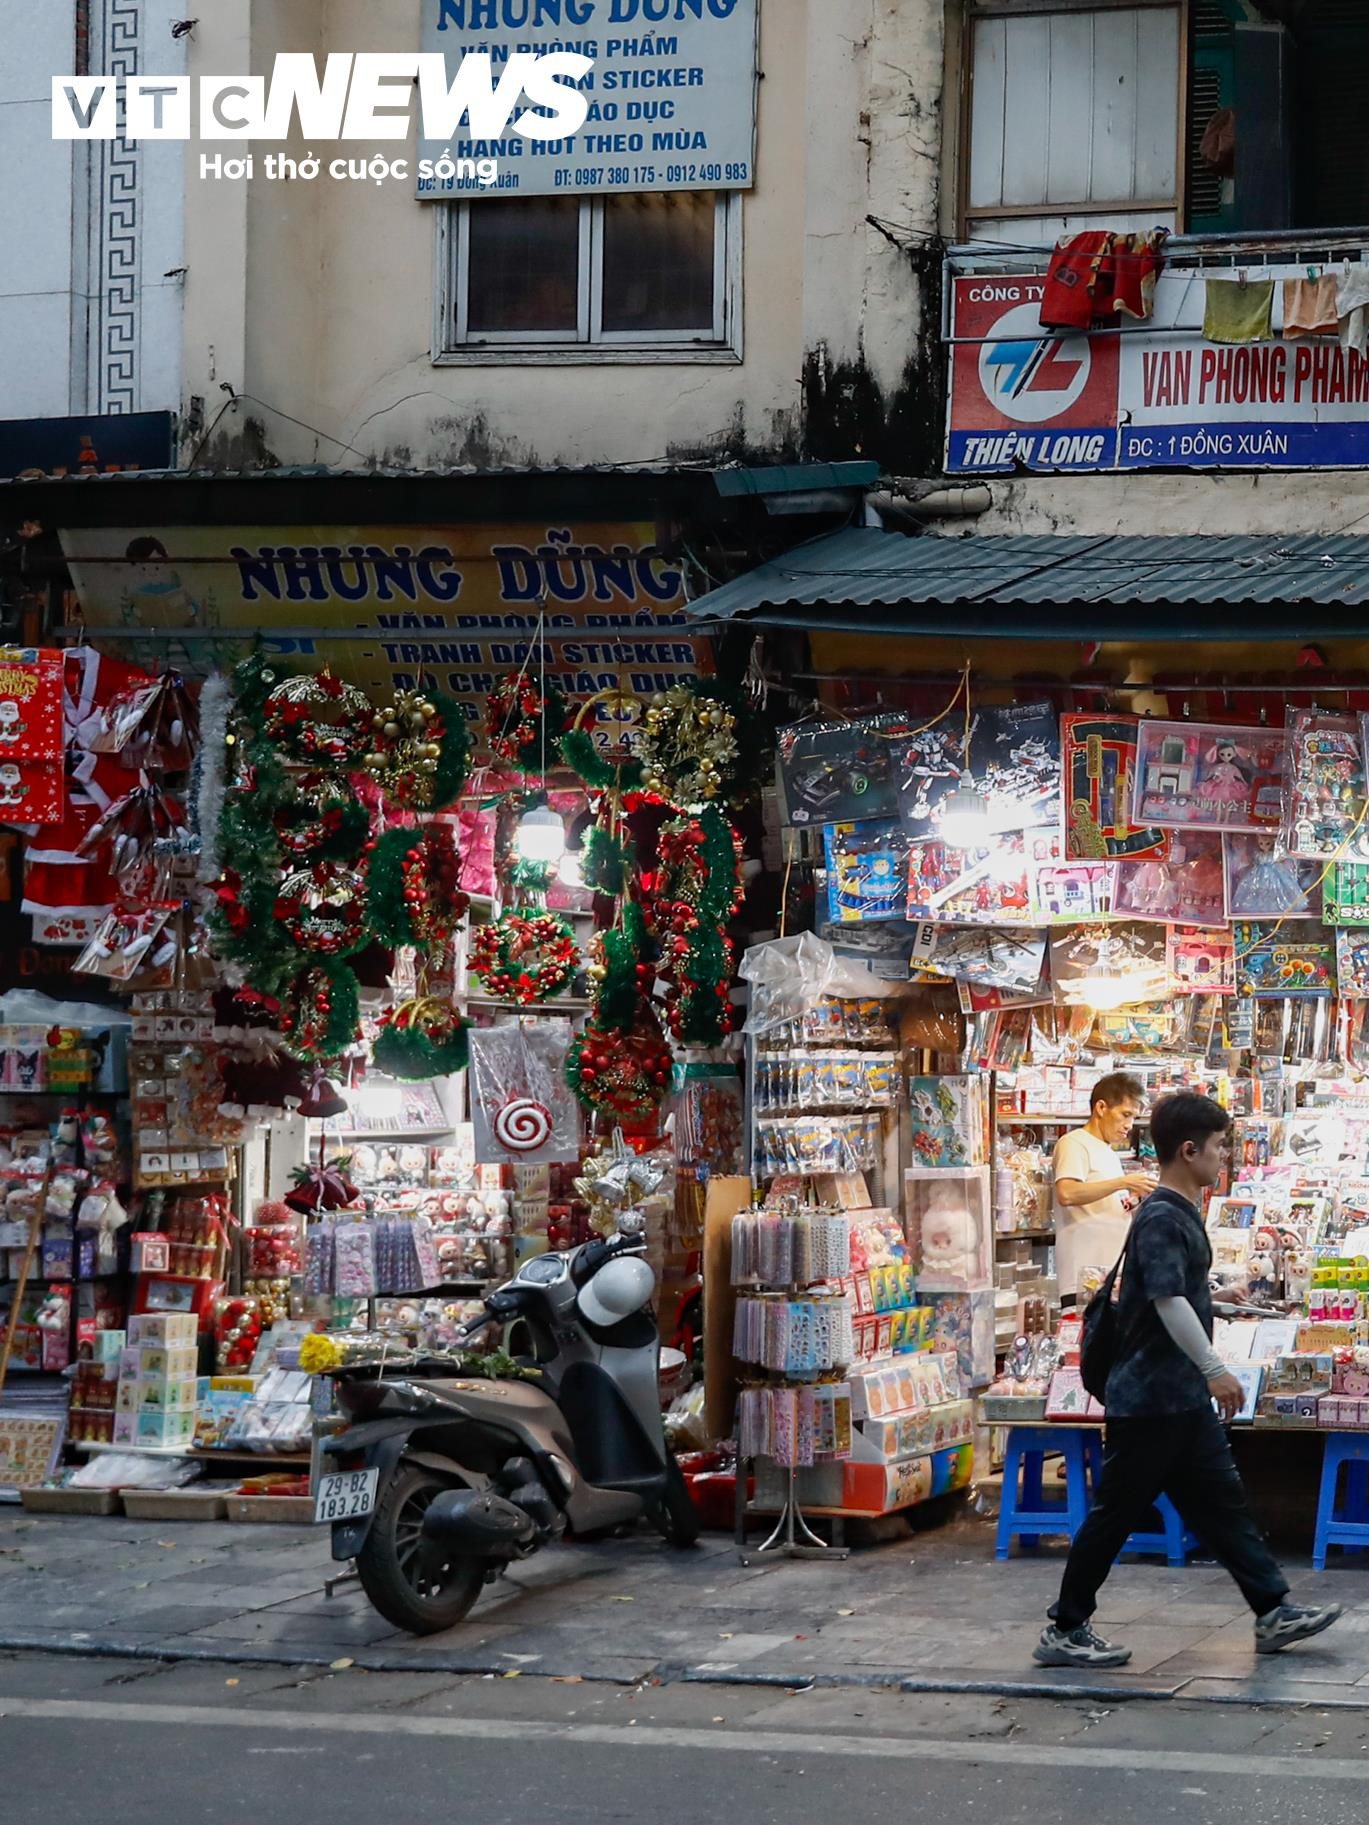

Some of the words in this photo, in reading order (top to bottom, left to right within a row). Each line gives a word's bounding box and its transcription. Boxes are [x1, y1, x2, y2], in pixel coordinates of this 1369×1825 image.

[603, 68, 704, 90] STICKER
[586, 100, 618, 122] ÁO
[627, 101, 675, 123] DỤC
[584, 134, 643, 154] THEO
[652, 129, 707, 152] MÙA
[554, 170, 572, 186] ĐT:
[575, 168, 604, 186] 0987
[608, 168, 629, 184] 380
[634, 166, 655, 183] 175
[666, 165, 696, 183] 0912
[700, 164, 722, 181] 490
[726, 163, 748, 180] 983
[969, 286, 1016, 303] CÔNG
[1037, 435, 1104, 463] LONG
[1128, 440, 1154, 457] ĐC
[1180, 433, 1232, 456] ĐỒNG
[1237, 433, 1288, 455] XUÂN
[230, 546, 463, 601] NHUNG
[492, 527, 687, 602] DŨNG
[380, 643, 482, 664] TRANH
[562, 643, 696, 664] STICKER
[325, 1472, 369, 1497] 29-B2
[320, 1493, 370, 1519] 183.28
